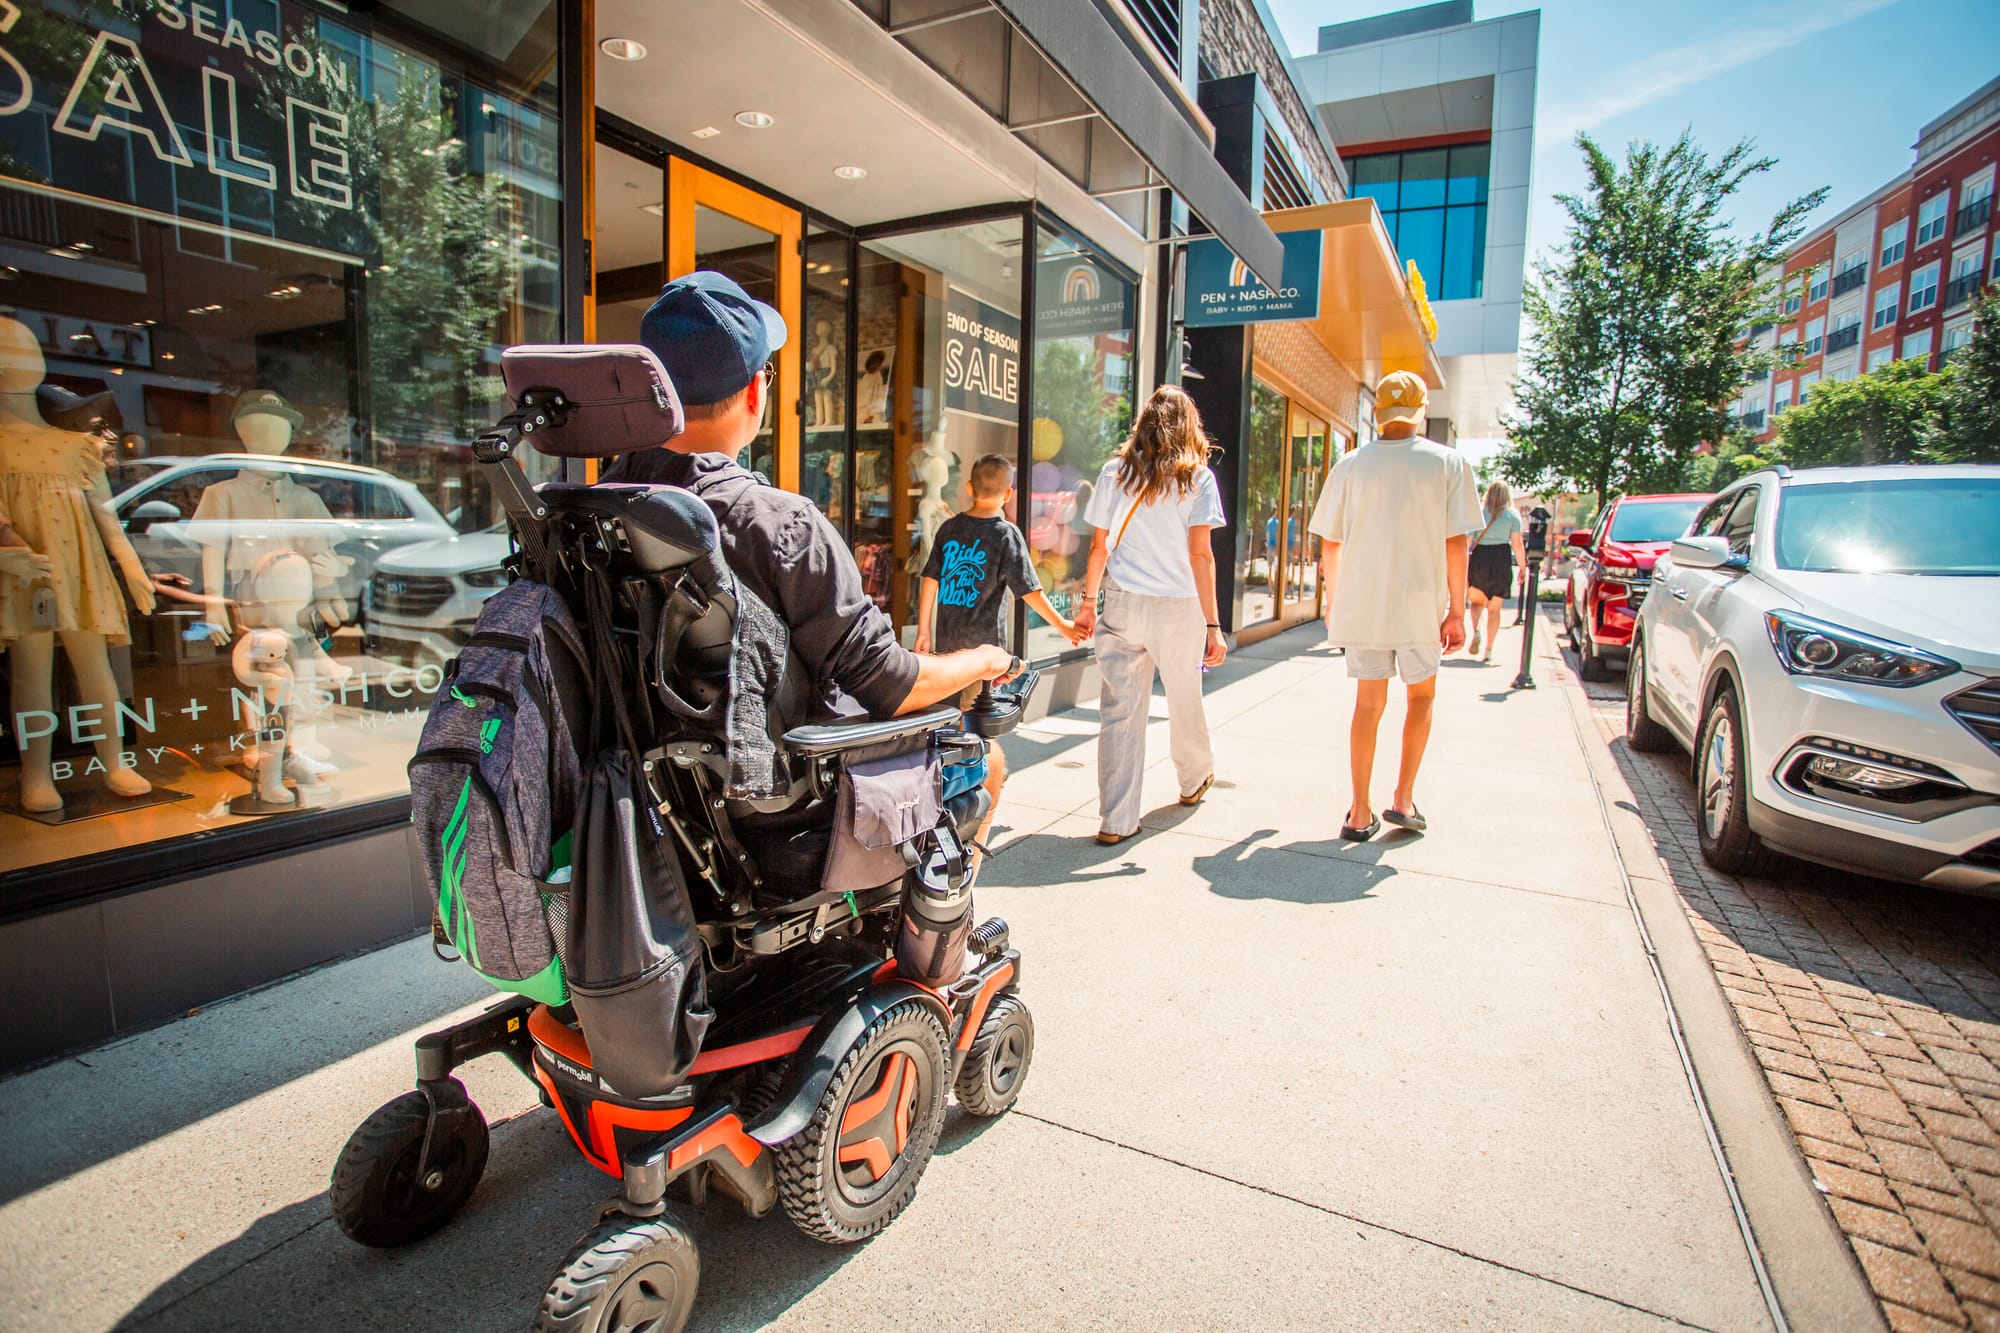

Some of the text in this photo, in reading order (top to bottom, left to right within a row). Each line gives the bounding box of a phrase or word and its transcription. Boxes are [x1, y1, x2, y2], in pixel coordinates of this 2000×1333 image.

[157, 0, 347, 91] SEASON
[1200, 292, 1226, 304] PEN
[1239, 288, 1275, 301] NASH
[1279, 287, 1301, 298] CO.
[1206, 306, 1228, 314] BABY
[1237, 304, 1258, 313] KIDS
[1266, 302, 1293, 311] MAMA
[947, 312, 1018, 353] END OF SEASON
[945, 338, 1018, 404] SALE
[941, 538, 987, 577] Ride
[938, 577, 978, 609] Wave
[15, 697, 157, 751] PEN
[230, 671, 369, 722] NASH
[51, 746, 166, 780] BABY
[229, 728, 287, 752] KID
[359, 706, 421, 730] MAM
[556, 1060, 593, 1083] permobil
